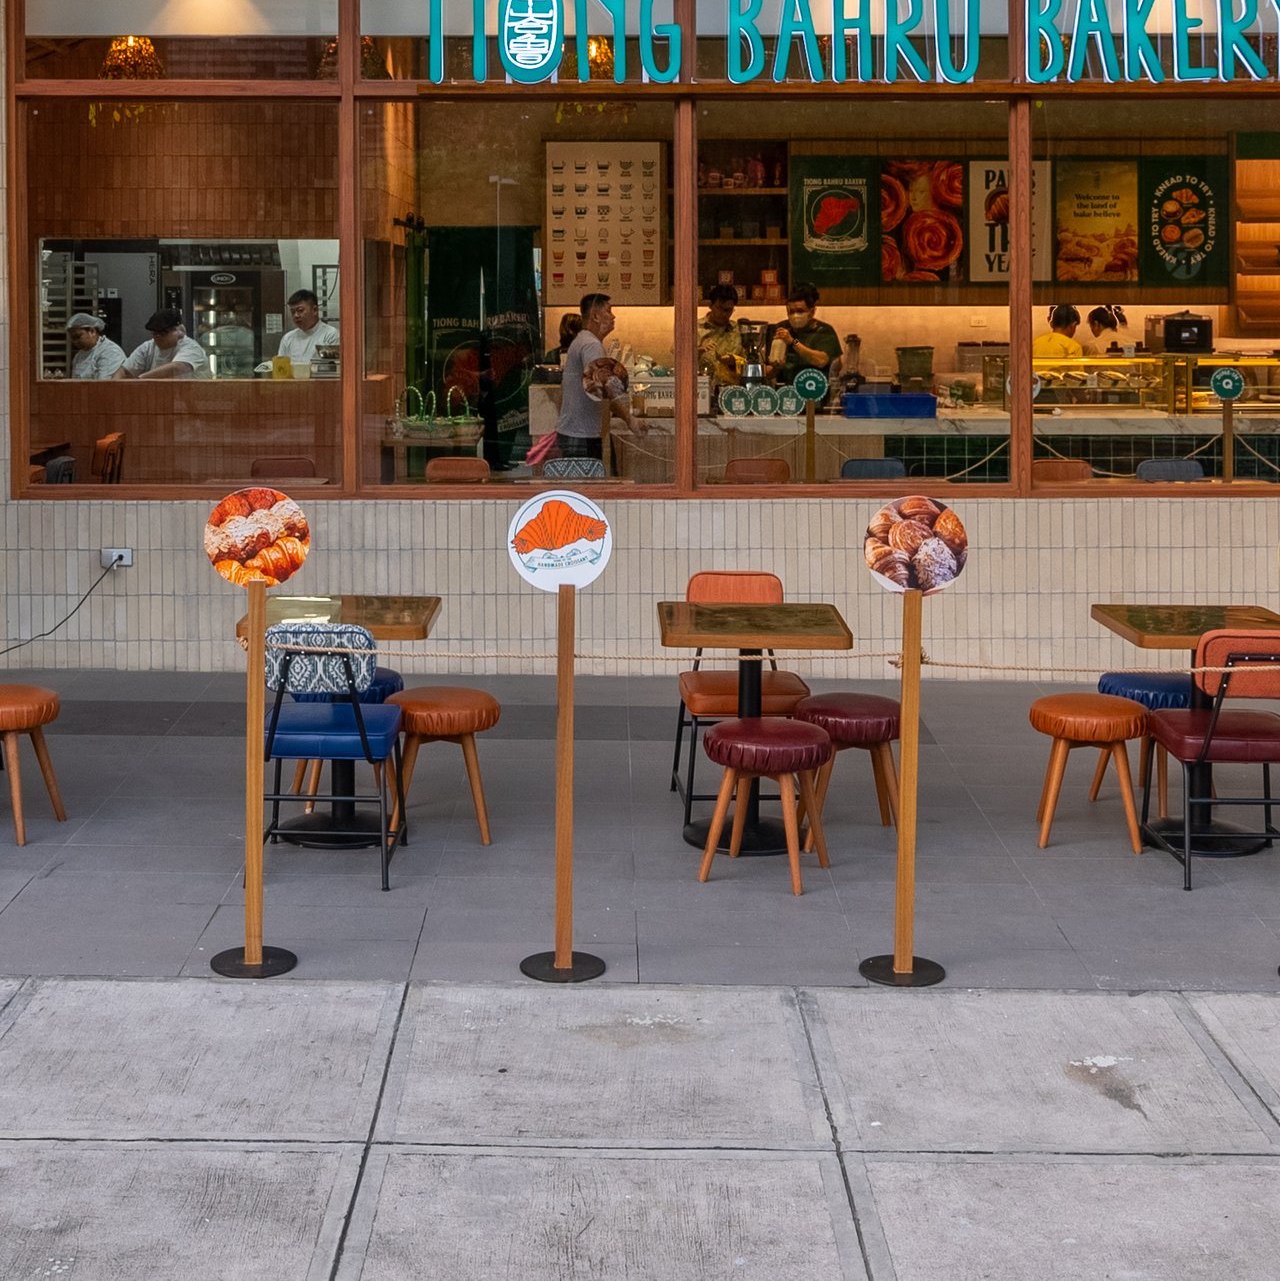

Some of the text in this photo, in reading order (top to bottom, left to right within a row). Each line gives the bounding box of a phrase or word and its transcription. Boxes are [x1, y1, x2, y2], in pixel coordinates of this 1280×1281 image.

[1154, 175, 1213, 197] KNEAD TO TRY
[1208, 208, 1216, 237] KNEAD
[1152, 225, 1159, 236] TO
[1153, 238, 1177, 264] KNEAD
[1205, 240, 1215, 252] TO
[1190, 251, 1207, 264] TRY
[432, 318, 459, 328] TIONG
[805, 380, 816, 391] Q
[1222, 379, 1233, 389] Q
